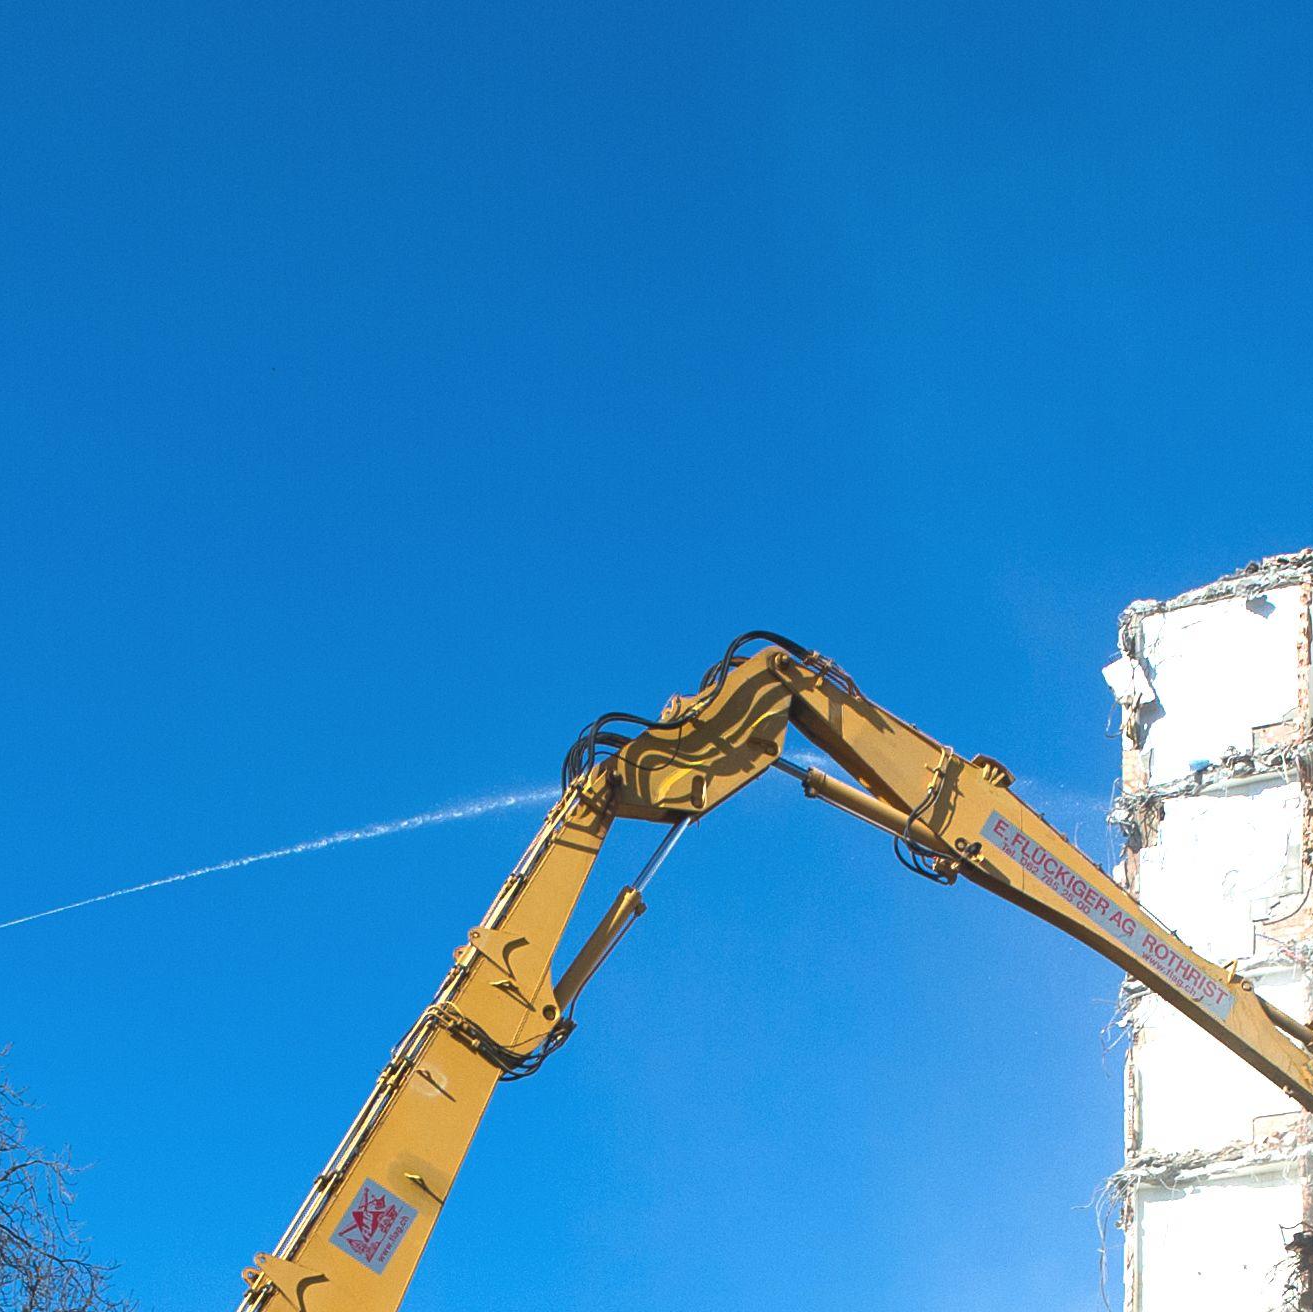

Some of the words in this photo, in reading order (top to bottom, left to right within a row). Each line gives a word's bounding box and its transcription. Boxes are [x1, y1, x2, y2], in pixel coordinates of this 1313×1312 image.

[993, 819, 1008, 841] E.
[1011, 832, 1110, 915] FLÜCKIGER
[1109, 911, 1136, 937] AG
[1142, 933, 1228, 1004] ROTHRIST
[1061, 889, 1073, 902] 25
[1076, 900, 1091, 914] 00
